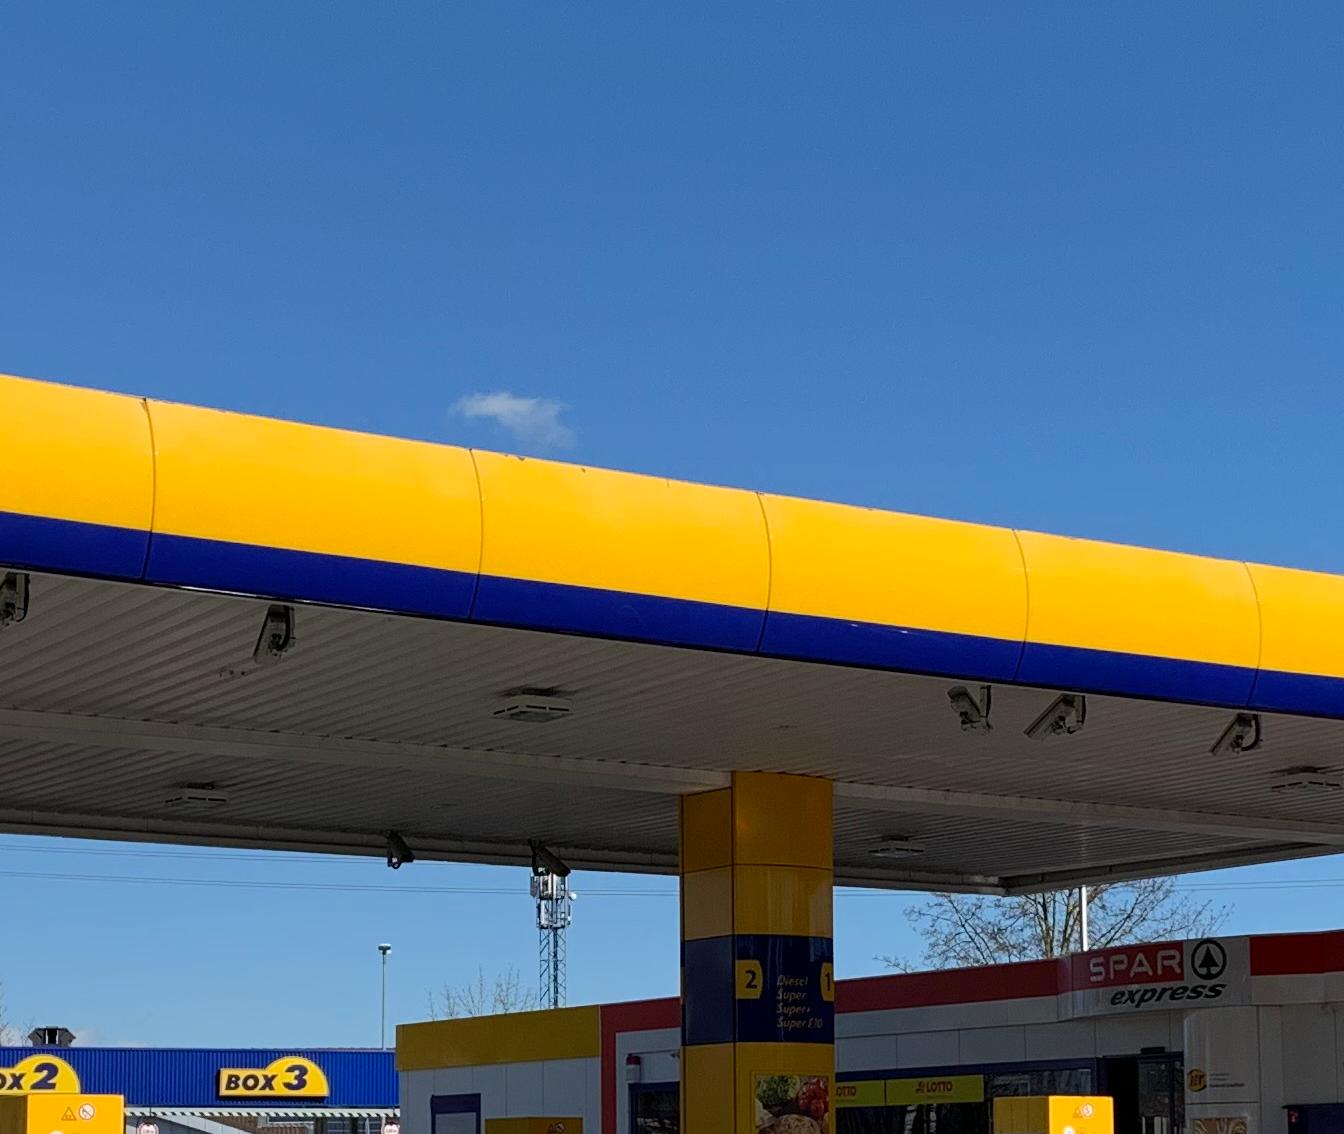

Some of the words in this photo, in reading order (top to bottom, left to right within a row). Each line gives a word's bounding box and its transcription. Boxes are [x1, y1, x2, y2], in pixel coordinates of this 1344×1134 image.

[1089, 949, 1182, 983] SPAR
[745, 970, 758, 989] 2
[776, 974, 809, 987] Diesel
[824, 972, 831, 992] 1
[776, 989, 807, 1003] Super
[1110, 983, 1227, 1008] express
[776, 1015, 807, 1031] Super
[29, 1062, 59, 1090] 2
[224, 1073, 278, 1091] BOX
[282, 1064, 309, 1091] 3
[836, 1085, 857, 1097] OTTO
[926, 1080, 953, 1093] LOTTO
